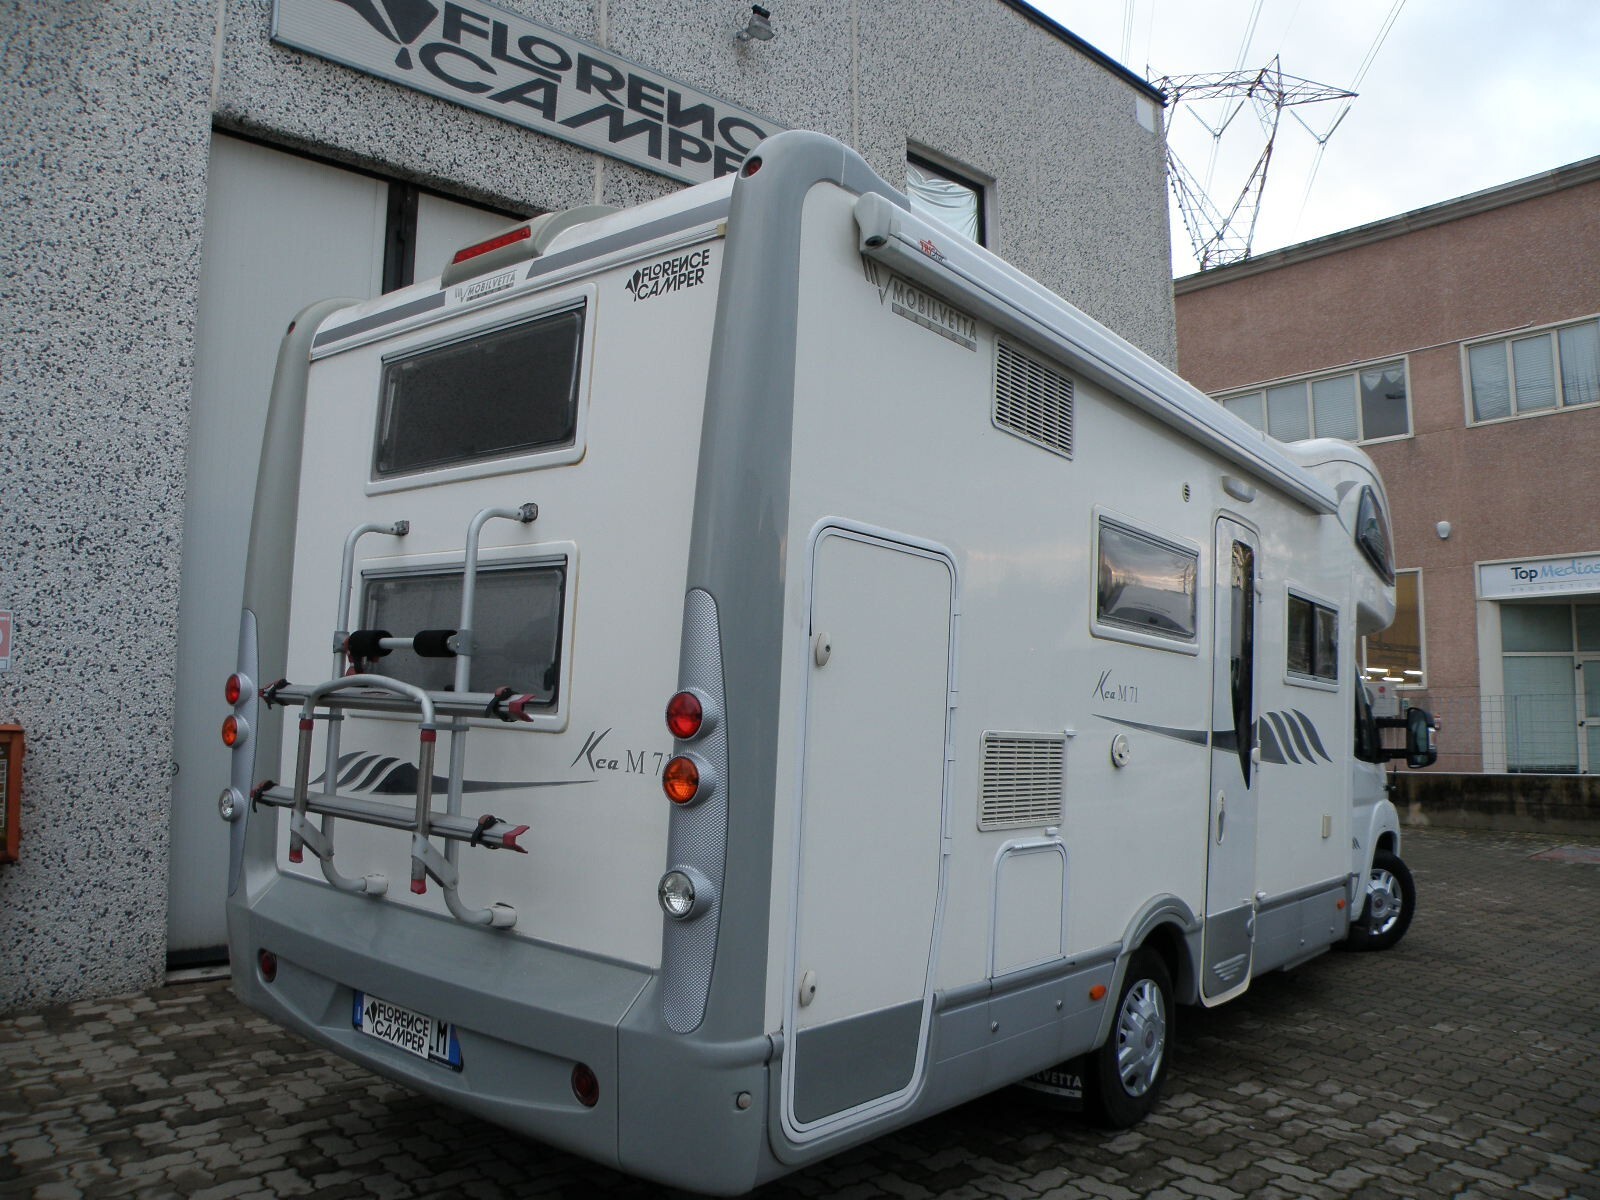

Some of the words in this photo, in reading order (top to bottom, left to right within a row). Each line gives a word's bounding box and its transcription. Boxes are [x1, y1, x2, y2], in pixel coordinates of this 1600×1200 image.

[442, 5, 768, 156] FLORENC
[419, 42, 745, 179] CAMPE
[637, 267, 705, 300] CAMPER
[641, 249, 710, 284] FLORENCE
[467, 271, 516, 297] MOBILVETTA
[892, 280, 977, 342] MOBILVETTA
[1092, 669, 1115, 701] Kea
[570, 728, 619, 772] Kea
[374, 1020, 425, 1054] CAMPER
[377, 1003, 430, 1037] FLORENCE
